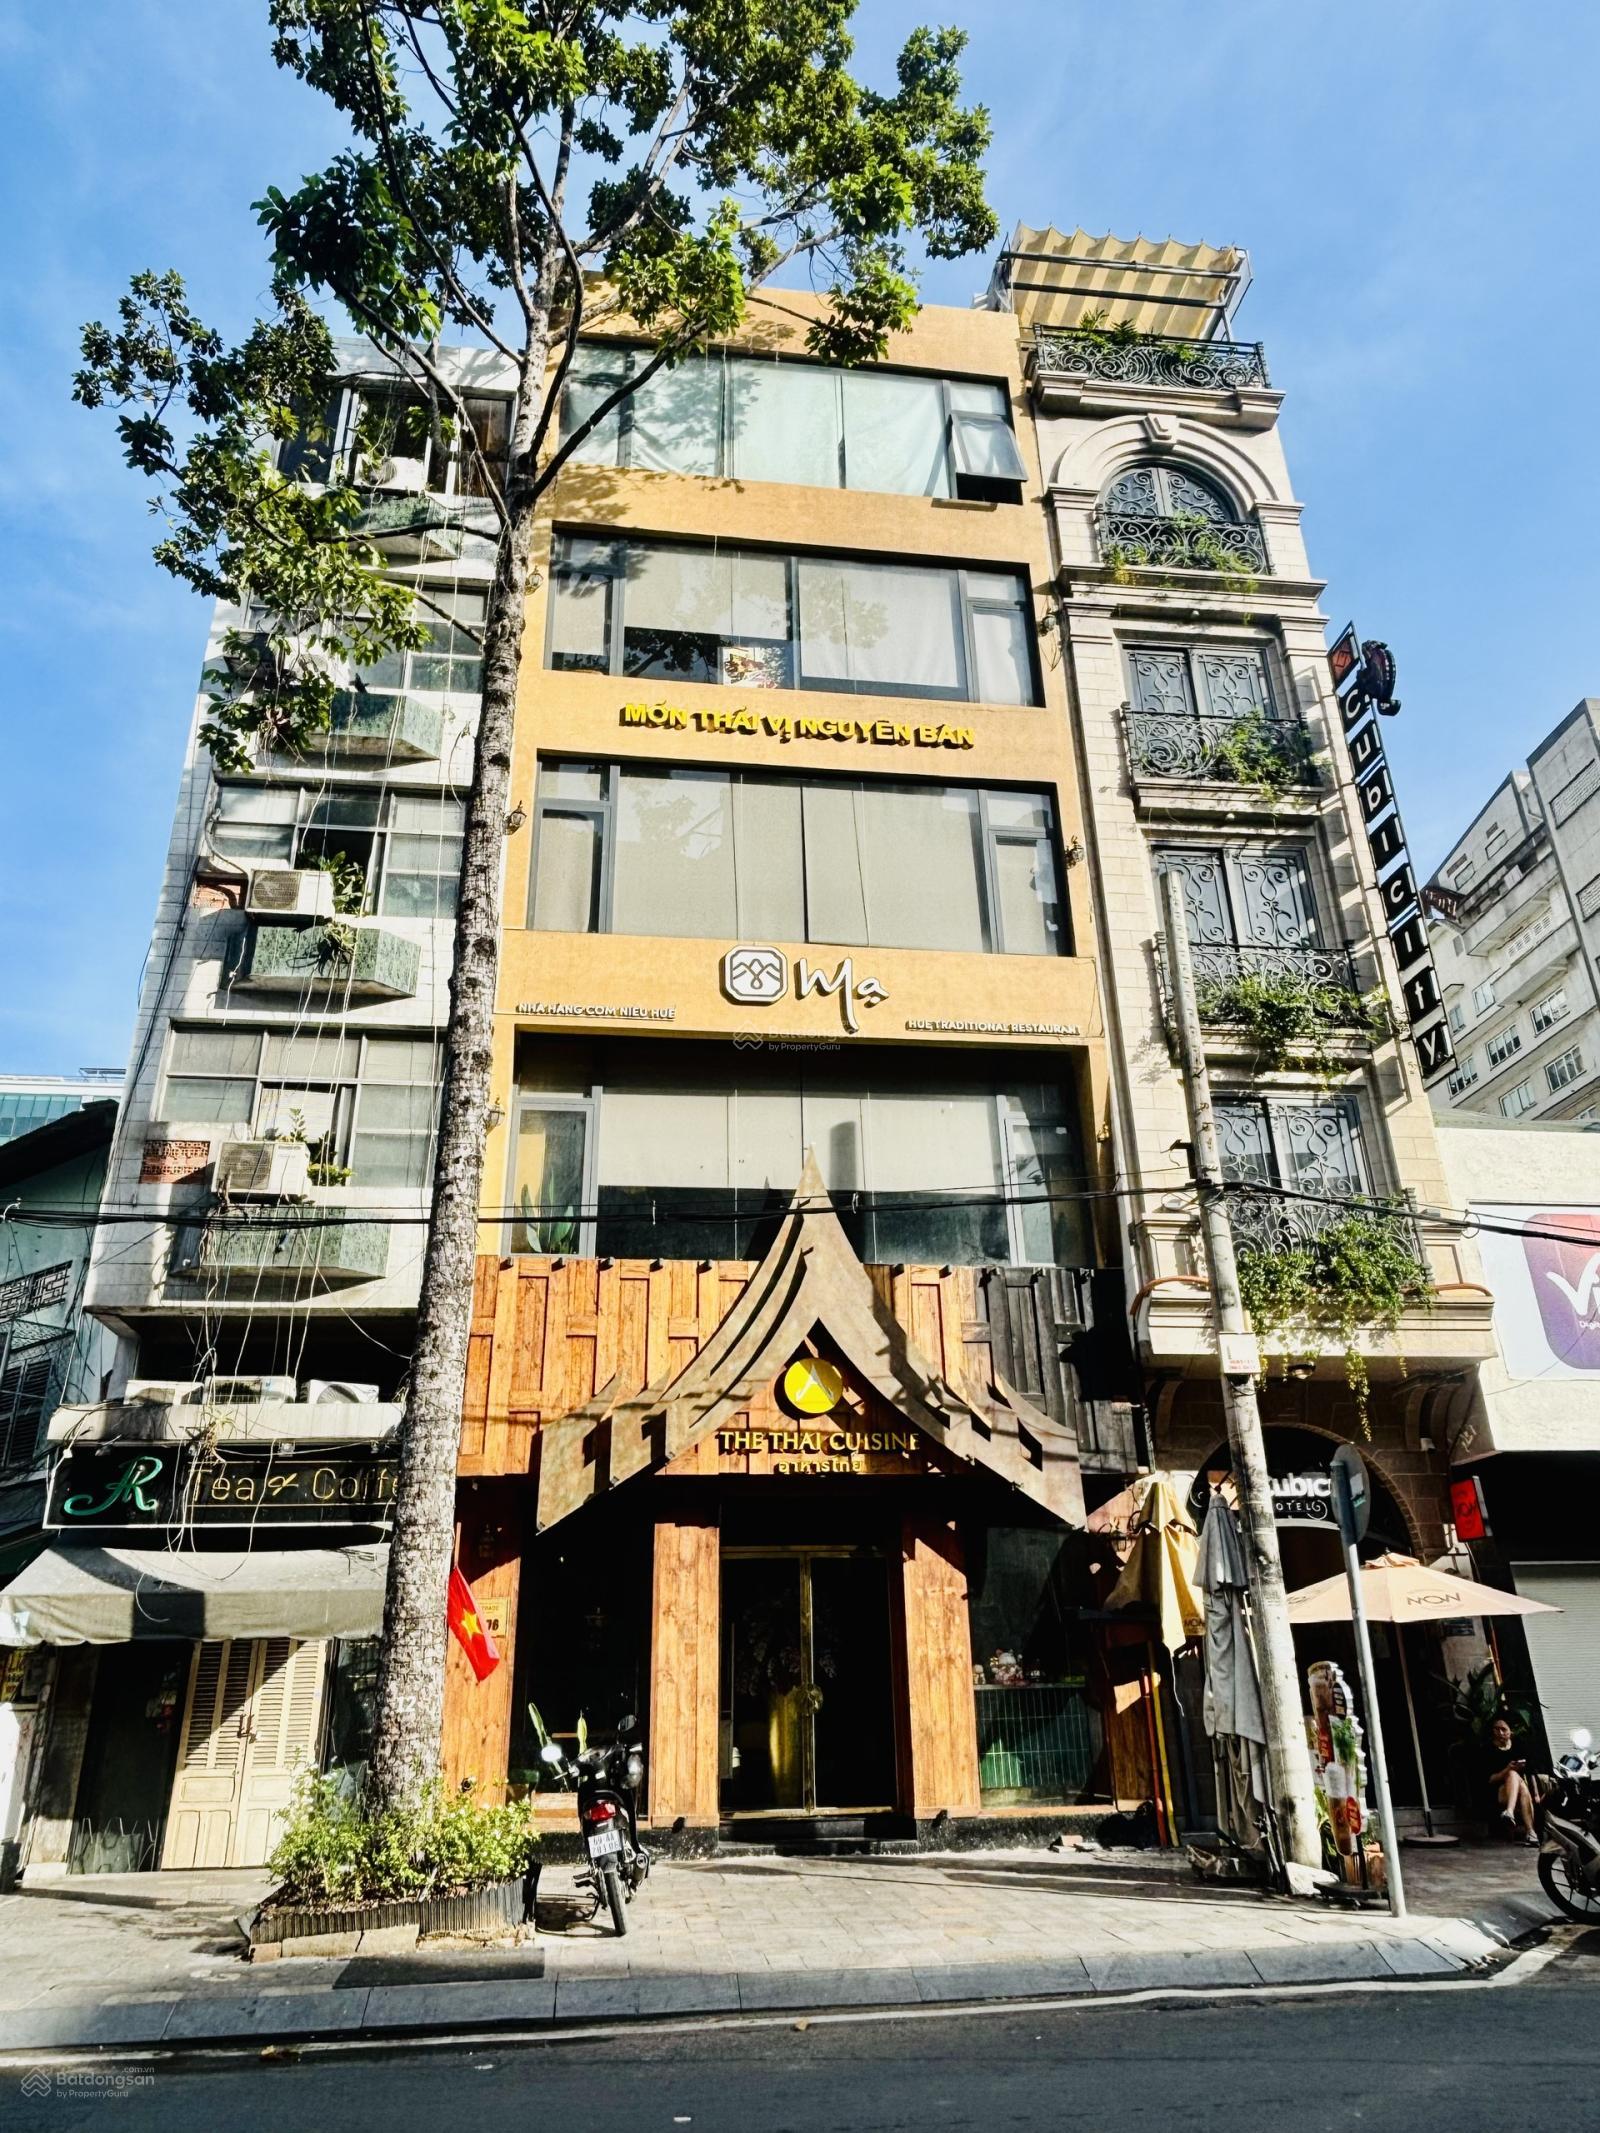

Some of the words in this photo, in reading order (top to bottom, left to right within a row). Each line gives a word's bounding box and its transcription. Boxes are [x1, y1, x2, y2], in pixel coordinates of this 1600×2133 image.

[935, 1021, 1009, 1033] TRADITIONAL
[1011, 1023, 1081, 1035] RESTAURANT
[720, 1431, 763, 1449] THE
[769, 1432, 821, 1449] THAI
[829, 1432, 920, 1450] CUISINE
[189, 1468, 255, 1502] Tea
